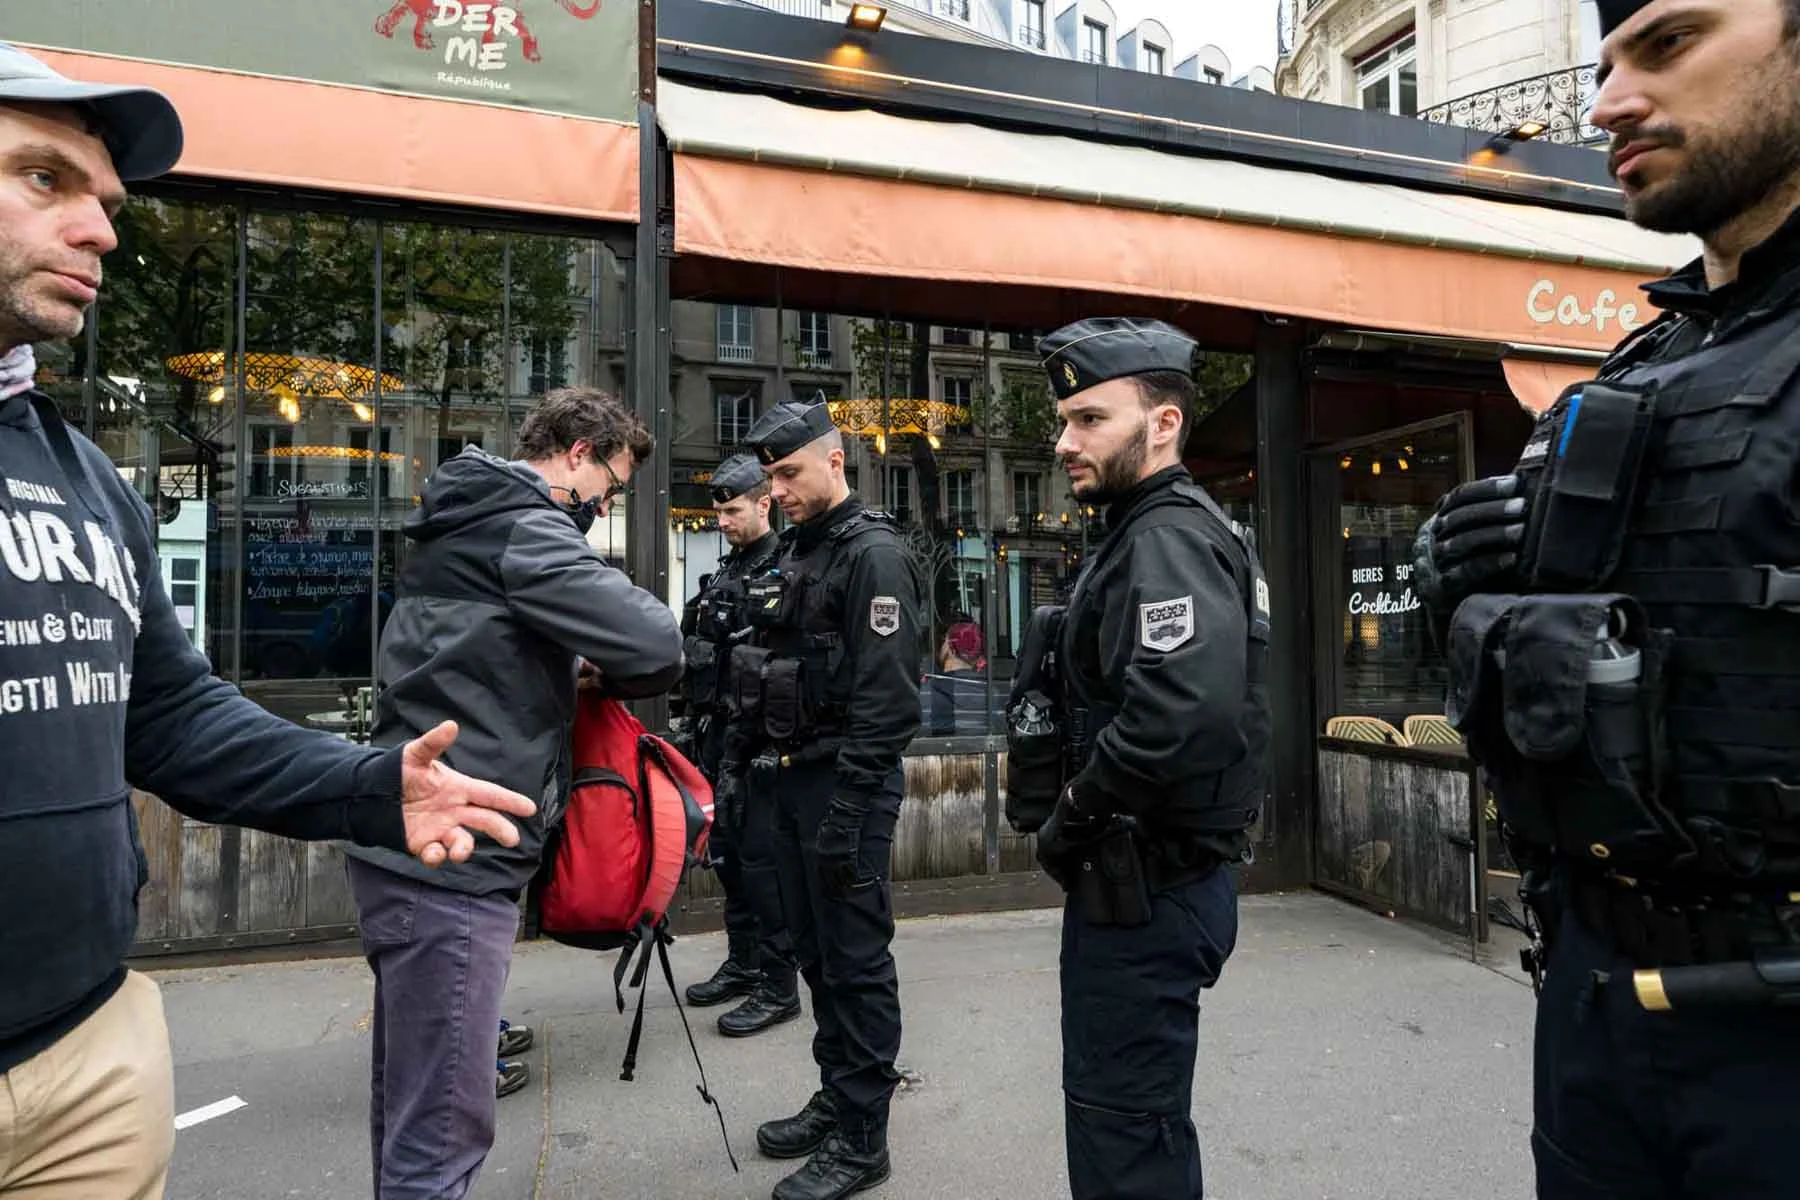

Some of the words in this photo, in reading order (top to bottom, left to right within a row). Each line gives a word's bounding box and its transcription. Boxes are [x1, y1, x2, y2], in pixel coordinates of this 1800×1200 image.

[432, 0, 519, 36] DER
[444, 36, 508, 71] ME
[1527, 279, 1644, 333] Cafe
[1352, 566, 1384, 584] BIERES
[1348, 587, 1421, 615] Cocktails
[42, 612, 67, 643] &
[0, 675, 59, 715] GTH
